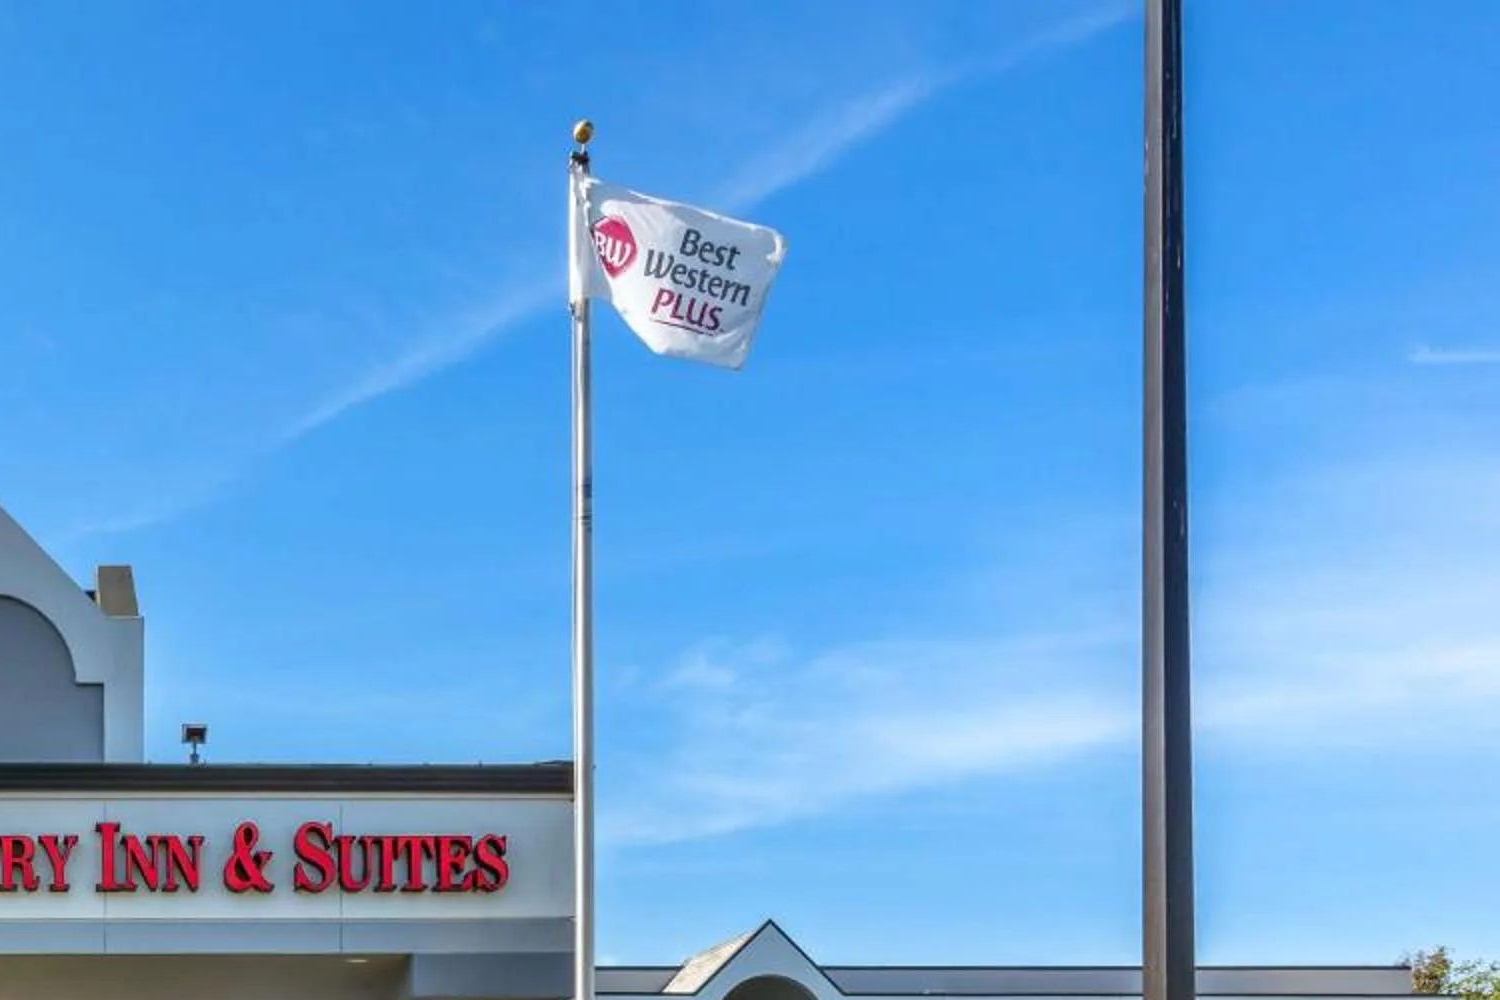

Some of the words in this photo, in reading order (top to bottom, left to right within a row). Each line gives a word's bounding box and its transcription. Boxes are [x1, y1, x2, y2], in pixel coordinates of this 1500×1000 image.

[680, 228, 741, 270] Best
[643, 248, 751, 307] Western
[651, 287, 723, 331] PLUS
[95, 821, 204, 892] INN
[223, 820, 274, 892] &
[293, 821, 509, 893] SUITES
